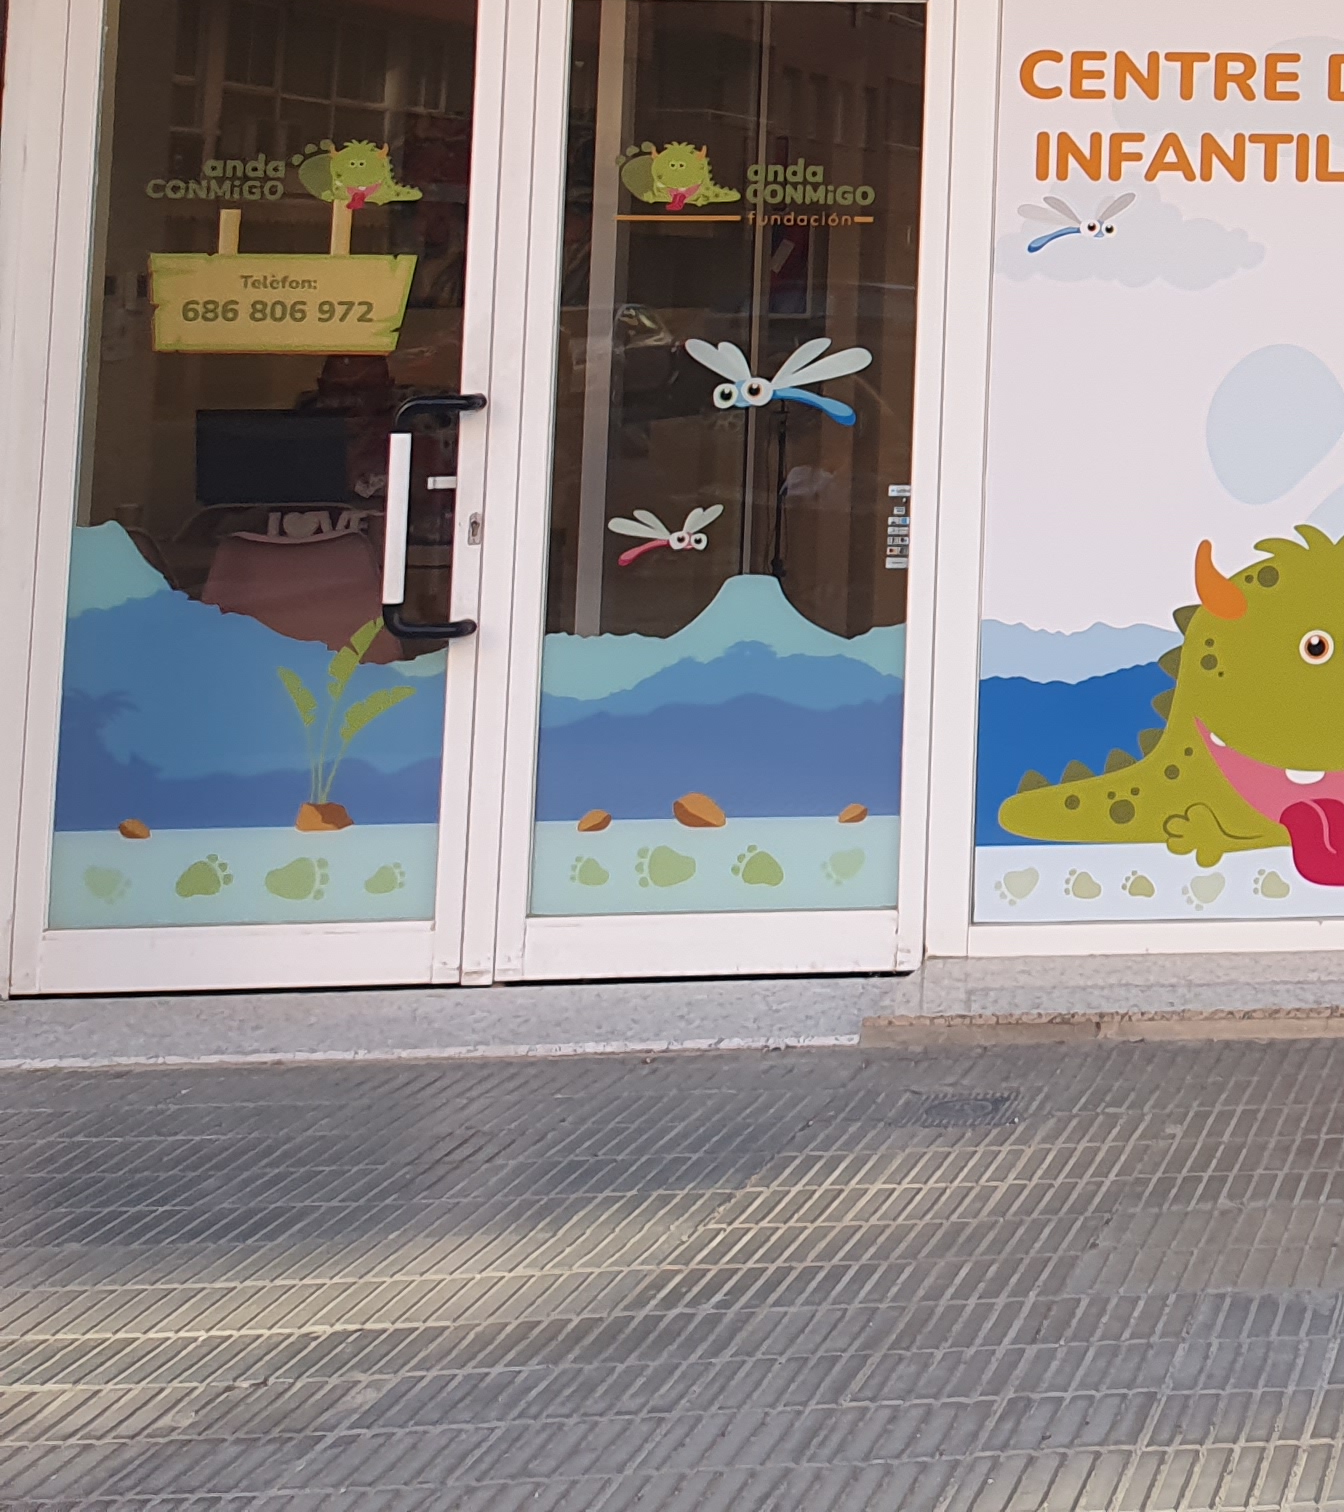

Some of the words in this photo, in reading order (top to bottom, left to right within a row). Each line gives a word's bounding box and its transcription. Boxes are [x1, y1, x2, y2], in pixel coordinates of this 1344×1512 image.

[1019, 49, 1302, 102] CENTRE
[203, 154, 286, 178] anda
[747, 158, 824, 183] anda
[748, 212, 852, 226] fundación
[240, 273, 318, 290] Telèfon:
[182, 299, 240, 323] 686
[249, 299, 307, 323] 806
[317, 300, 374, 324] 972
